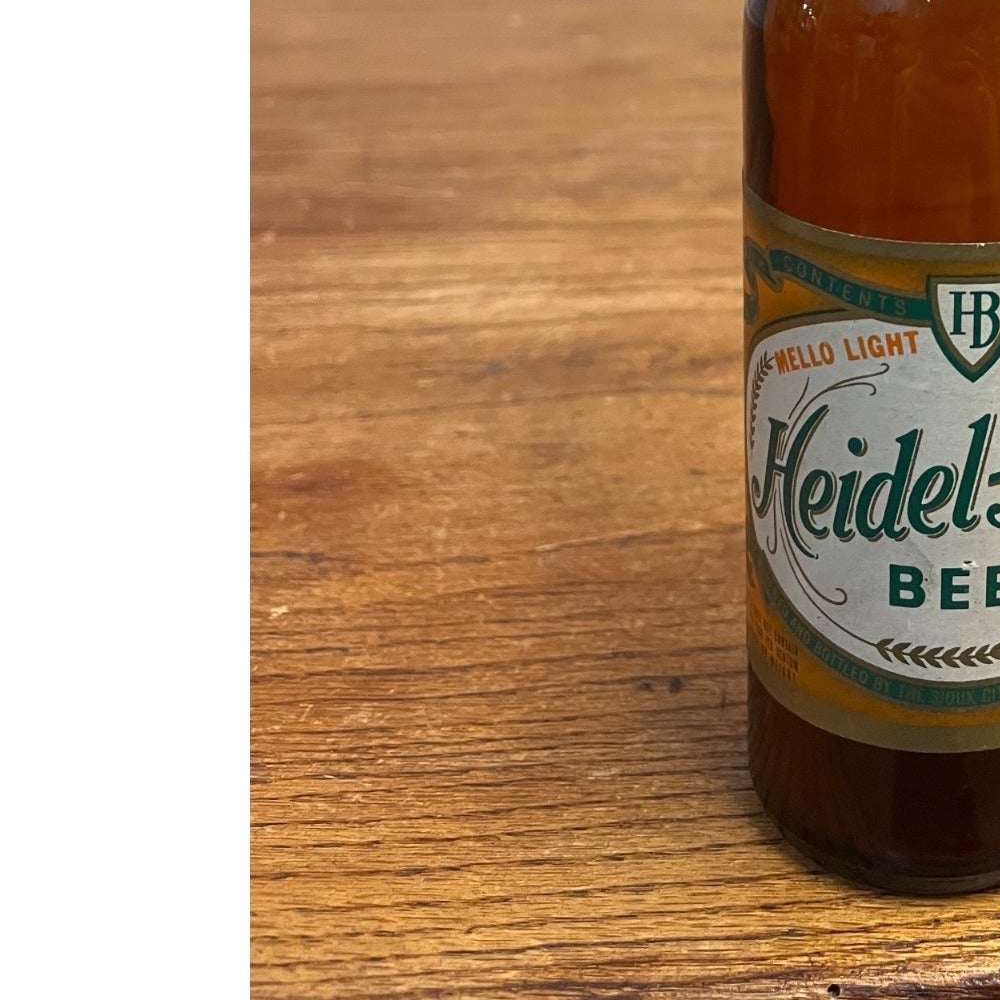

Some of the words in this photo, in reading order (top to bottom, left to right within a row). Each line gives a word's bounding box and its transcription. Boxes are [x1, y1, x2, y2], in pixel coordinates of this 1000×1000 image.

[784, 255, 906, 316] CONTENTS
[949, 291, 1000, 348] HB
[774, 341, 835, 375] MELLO
[843, 330, 918, 361] LIGHT
[815, 641, 868, 684] BOTTLED
[875, 679, 892, 696] BY
[933, 688, 975, 705] SIOUX
